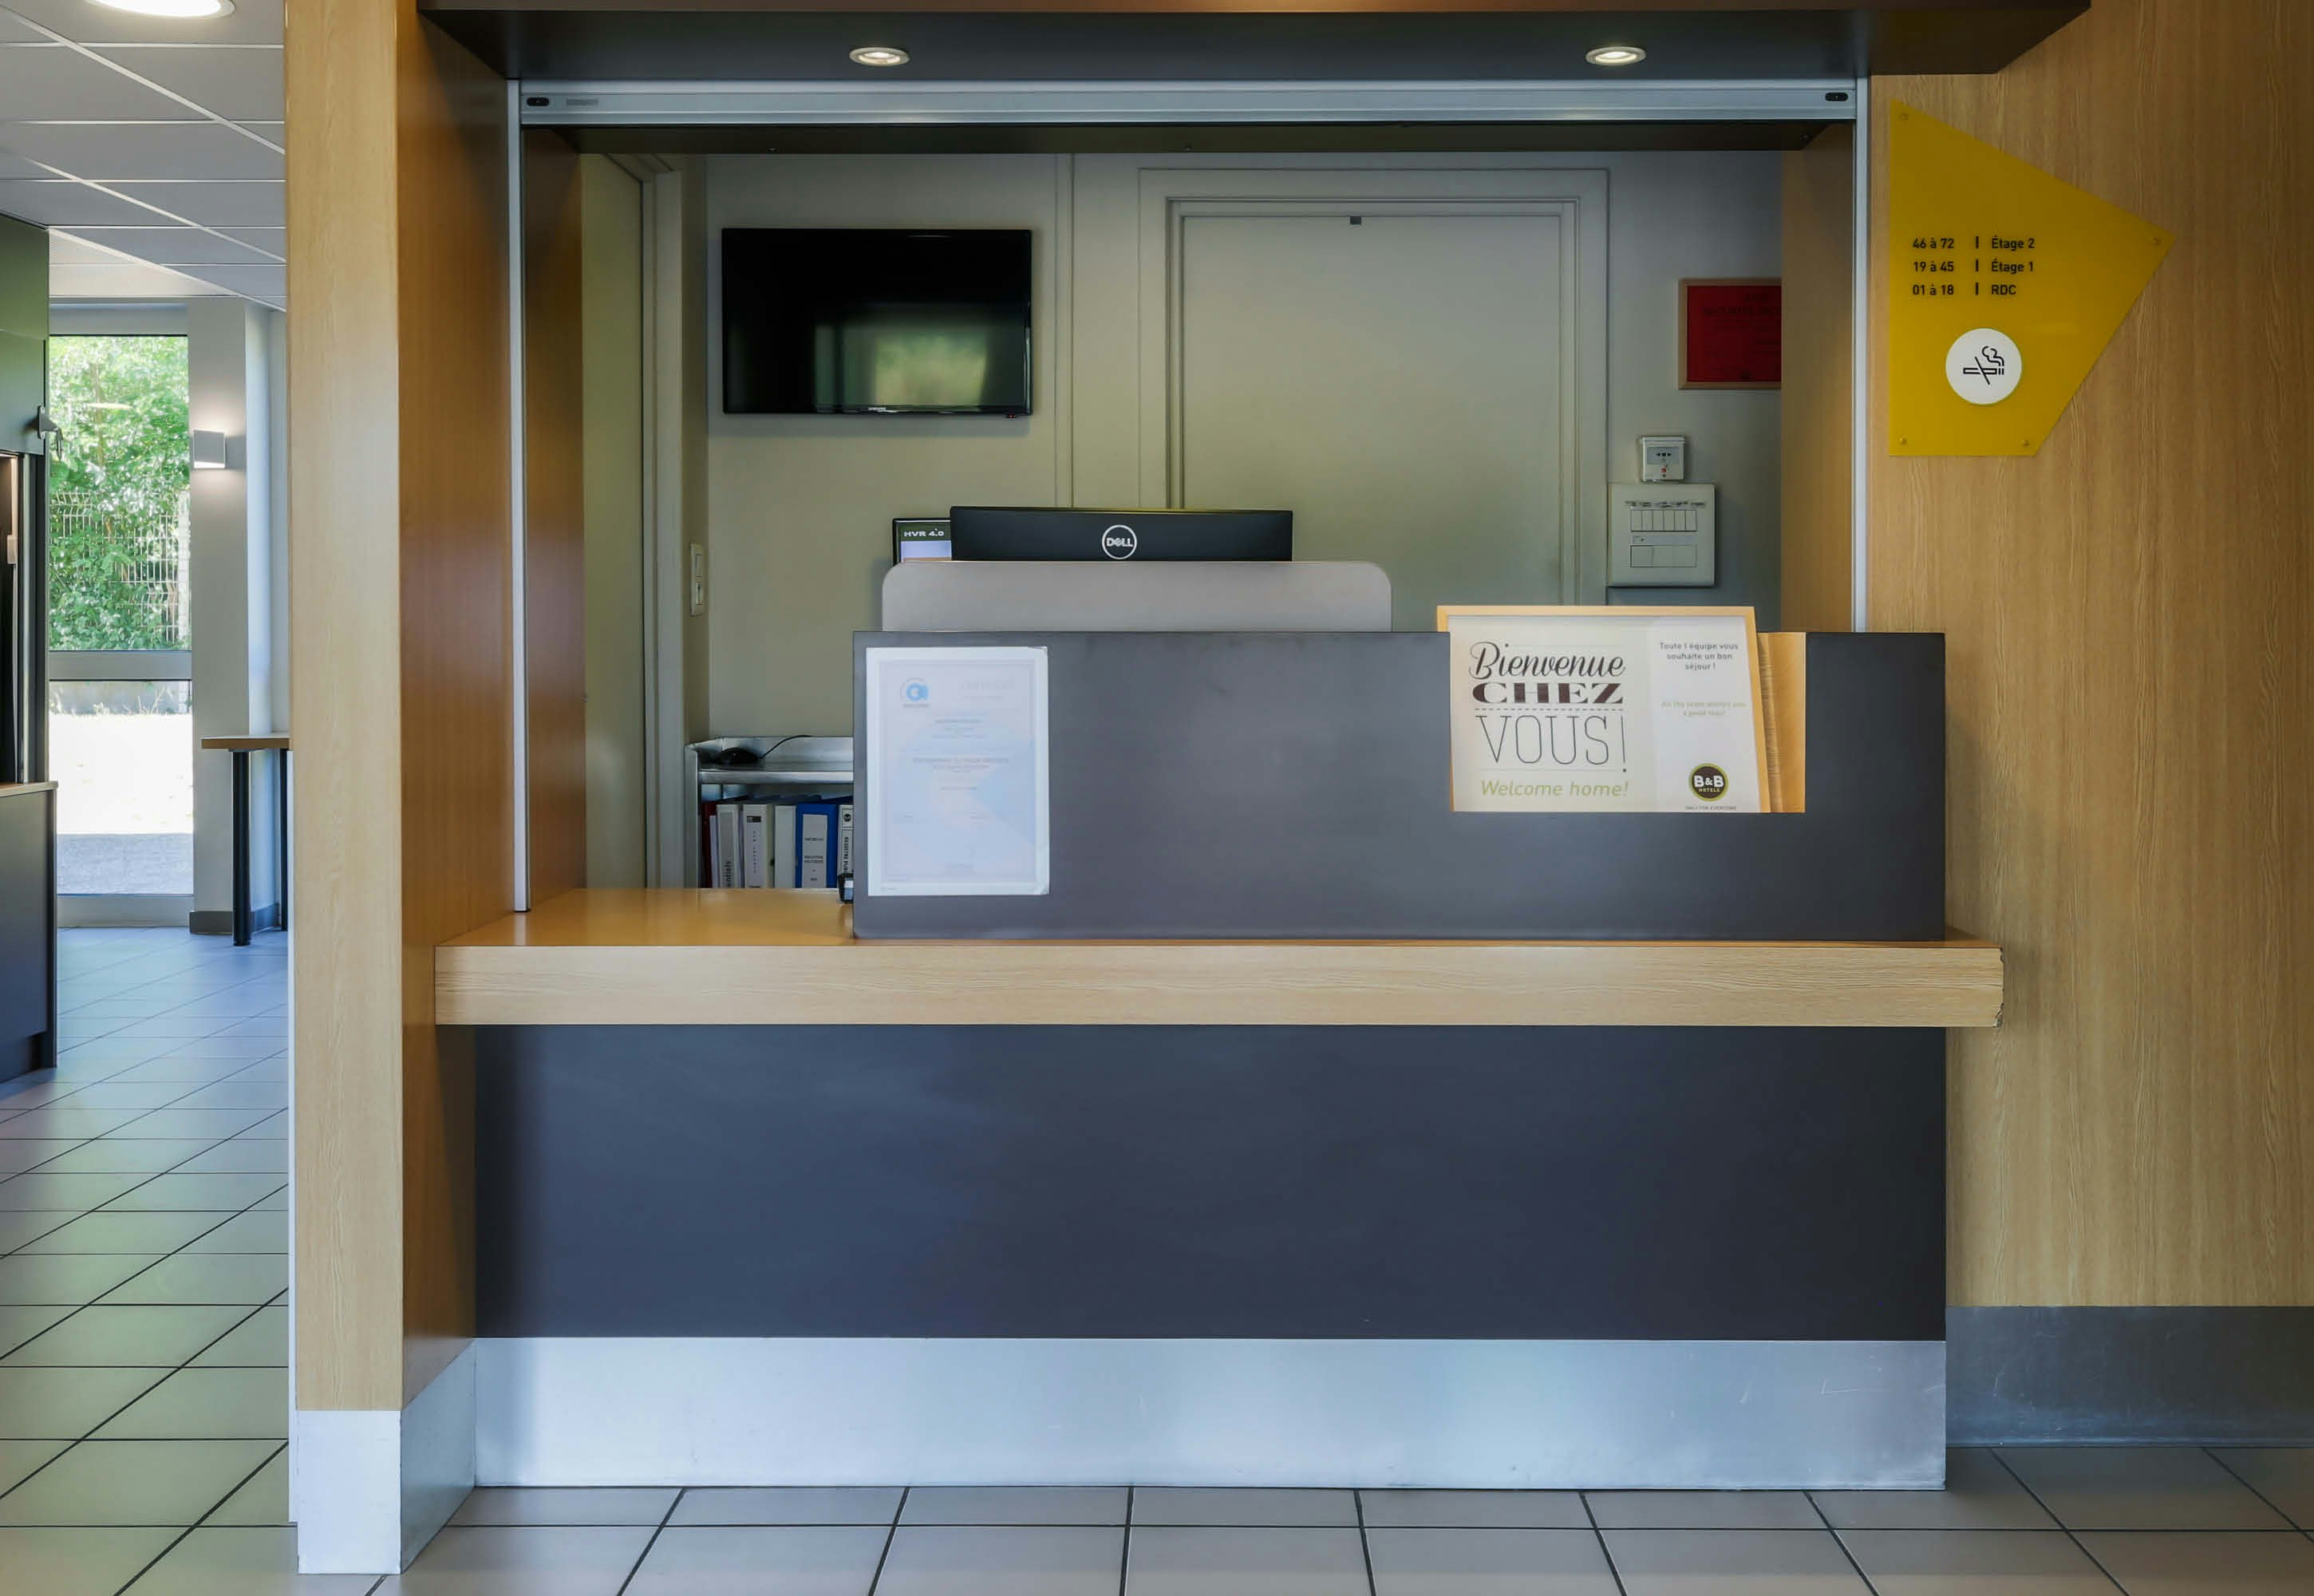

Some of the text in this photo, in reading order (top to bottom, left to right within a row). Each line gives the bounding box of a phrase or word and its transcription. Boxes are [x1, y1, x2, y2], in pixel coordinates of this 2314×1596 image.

[1913, 235, 2035, 251] 46 à 72 Étage 2
[1913, 259, 2034, 275] 19 à 45 Étage 1
[1912, 283, 2016, 295] 01 à 18 RDC
[1106, 537, 1134, 547] DELL
[1659, 642, 1682, 650] Toute
[1469, 641, 1626, 680] Bienvenue
[1472, 682, 1624, 704] CHEZ
[1481, 780, 1629, 797] Welcome home!
[1693, 775, 1724, 788] B&B
